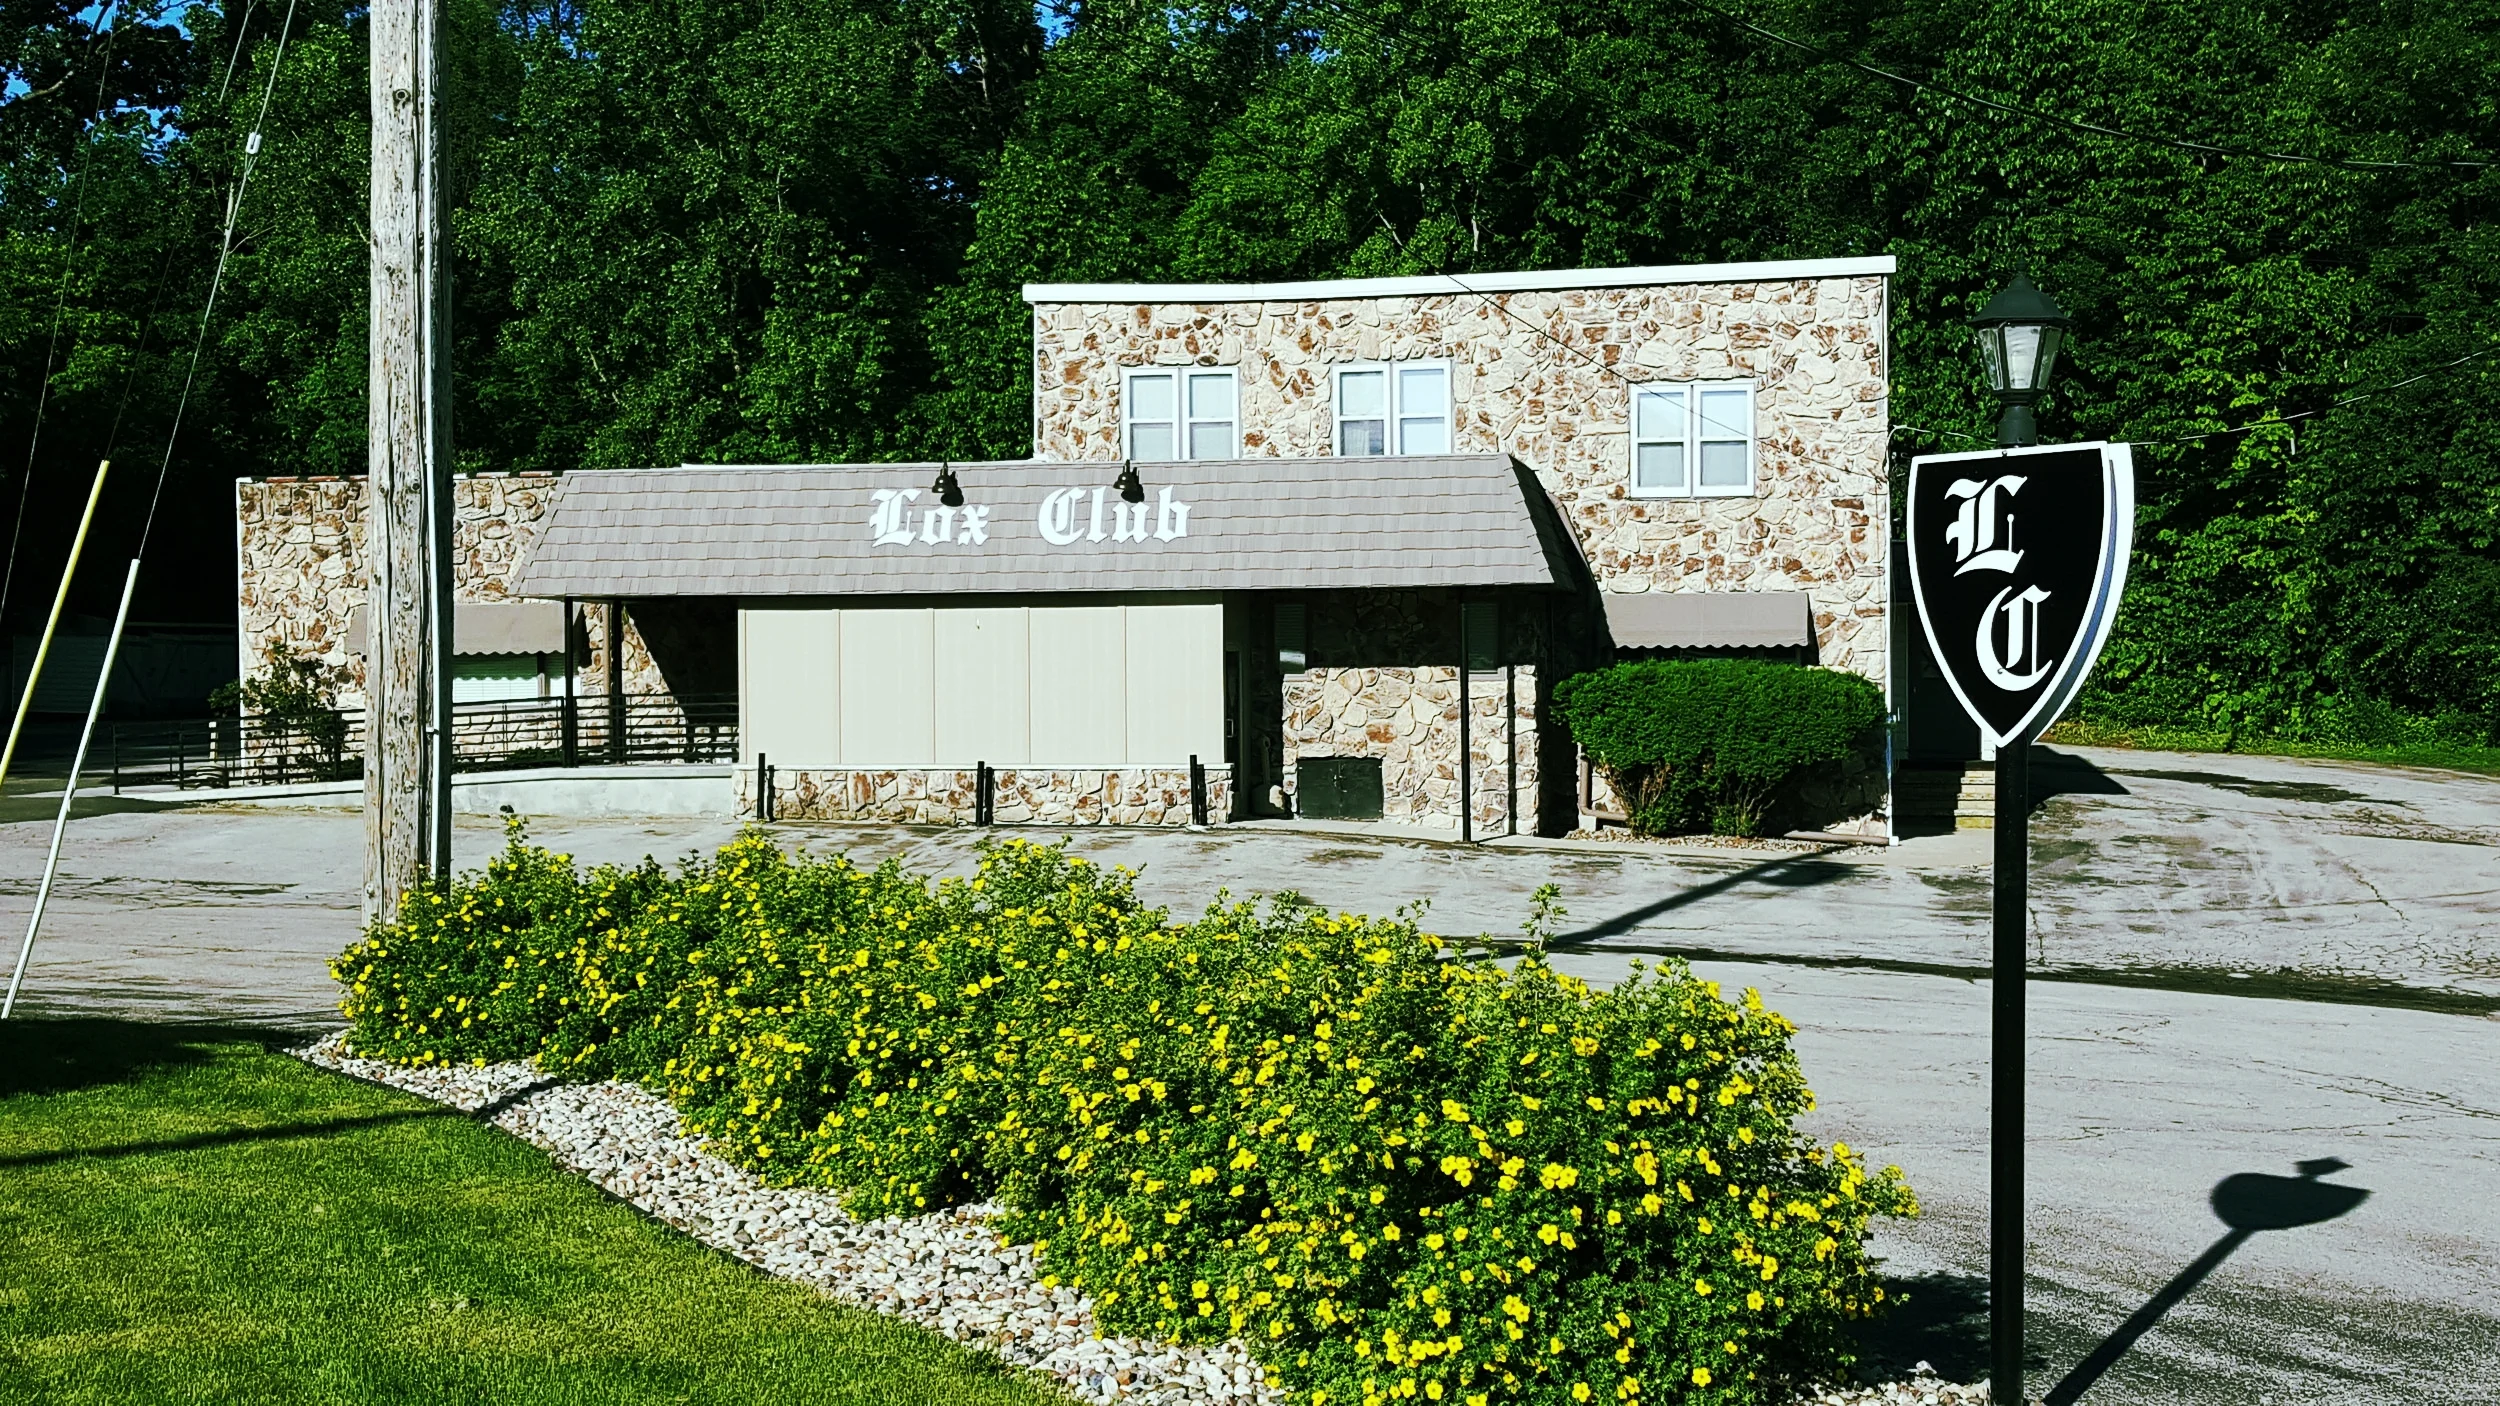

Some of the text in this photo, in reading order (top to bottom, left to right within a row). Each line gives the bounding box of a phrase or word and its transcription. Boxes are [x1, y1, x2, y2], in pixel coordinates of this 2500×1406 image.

[869, 485, 1192, 548] Lox Club
[1944, 475, 2028, 577] L
[1976, 584, 2053, 692] C
